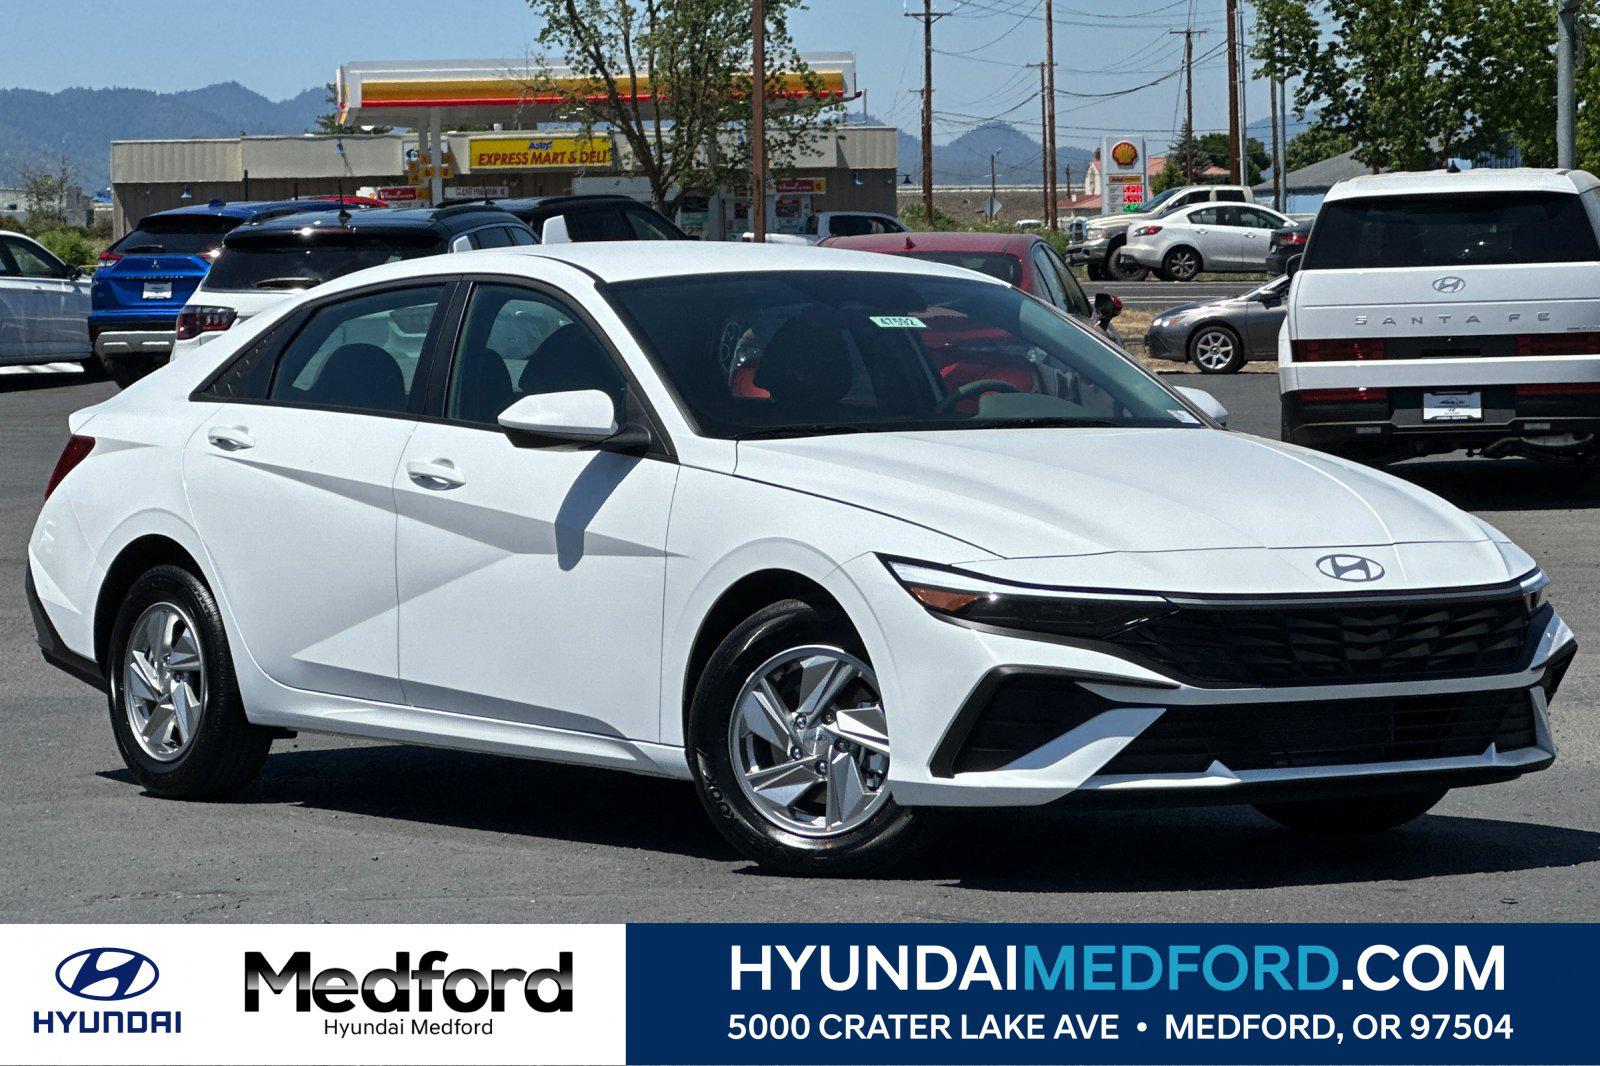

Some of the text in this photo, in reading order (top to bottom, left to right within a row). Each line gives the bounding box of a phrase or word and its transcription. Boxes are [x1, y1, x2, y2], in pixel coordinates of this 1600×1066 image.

[478, 150, 607, 166] EXPRESS MART & DELI
[1354, 312, 1550, 326] SANTA FE
